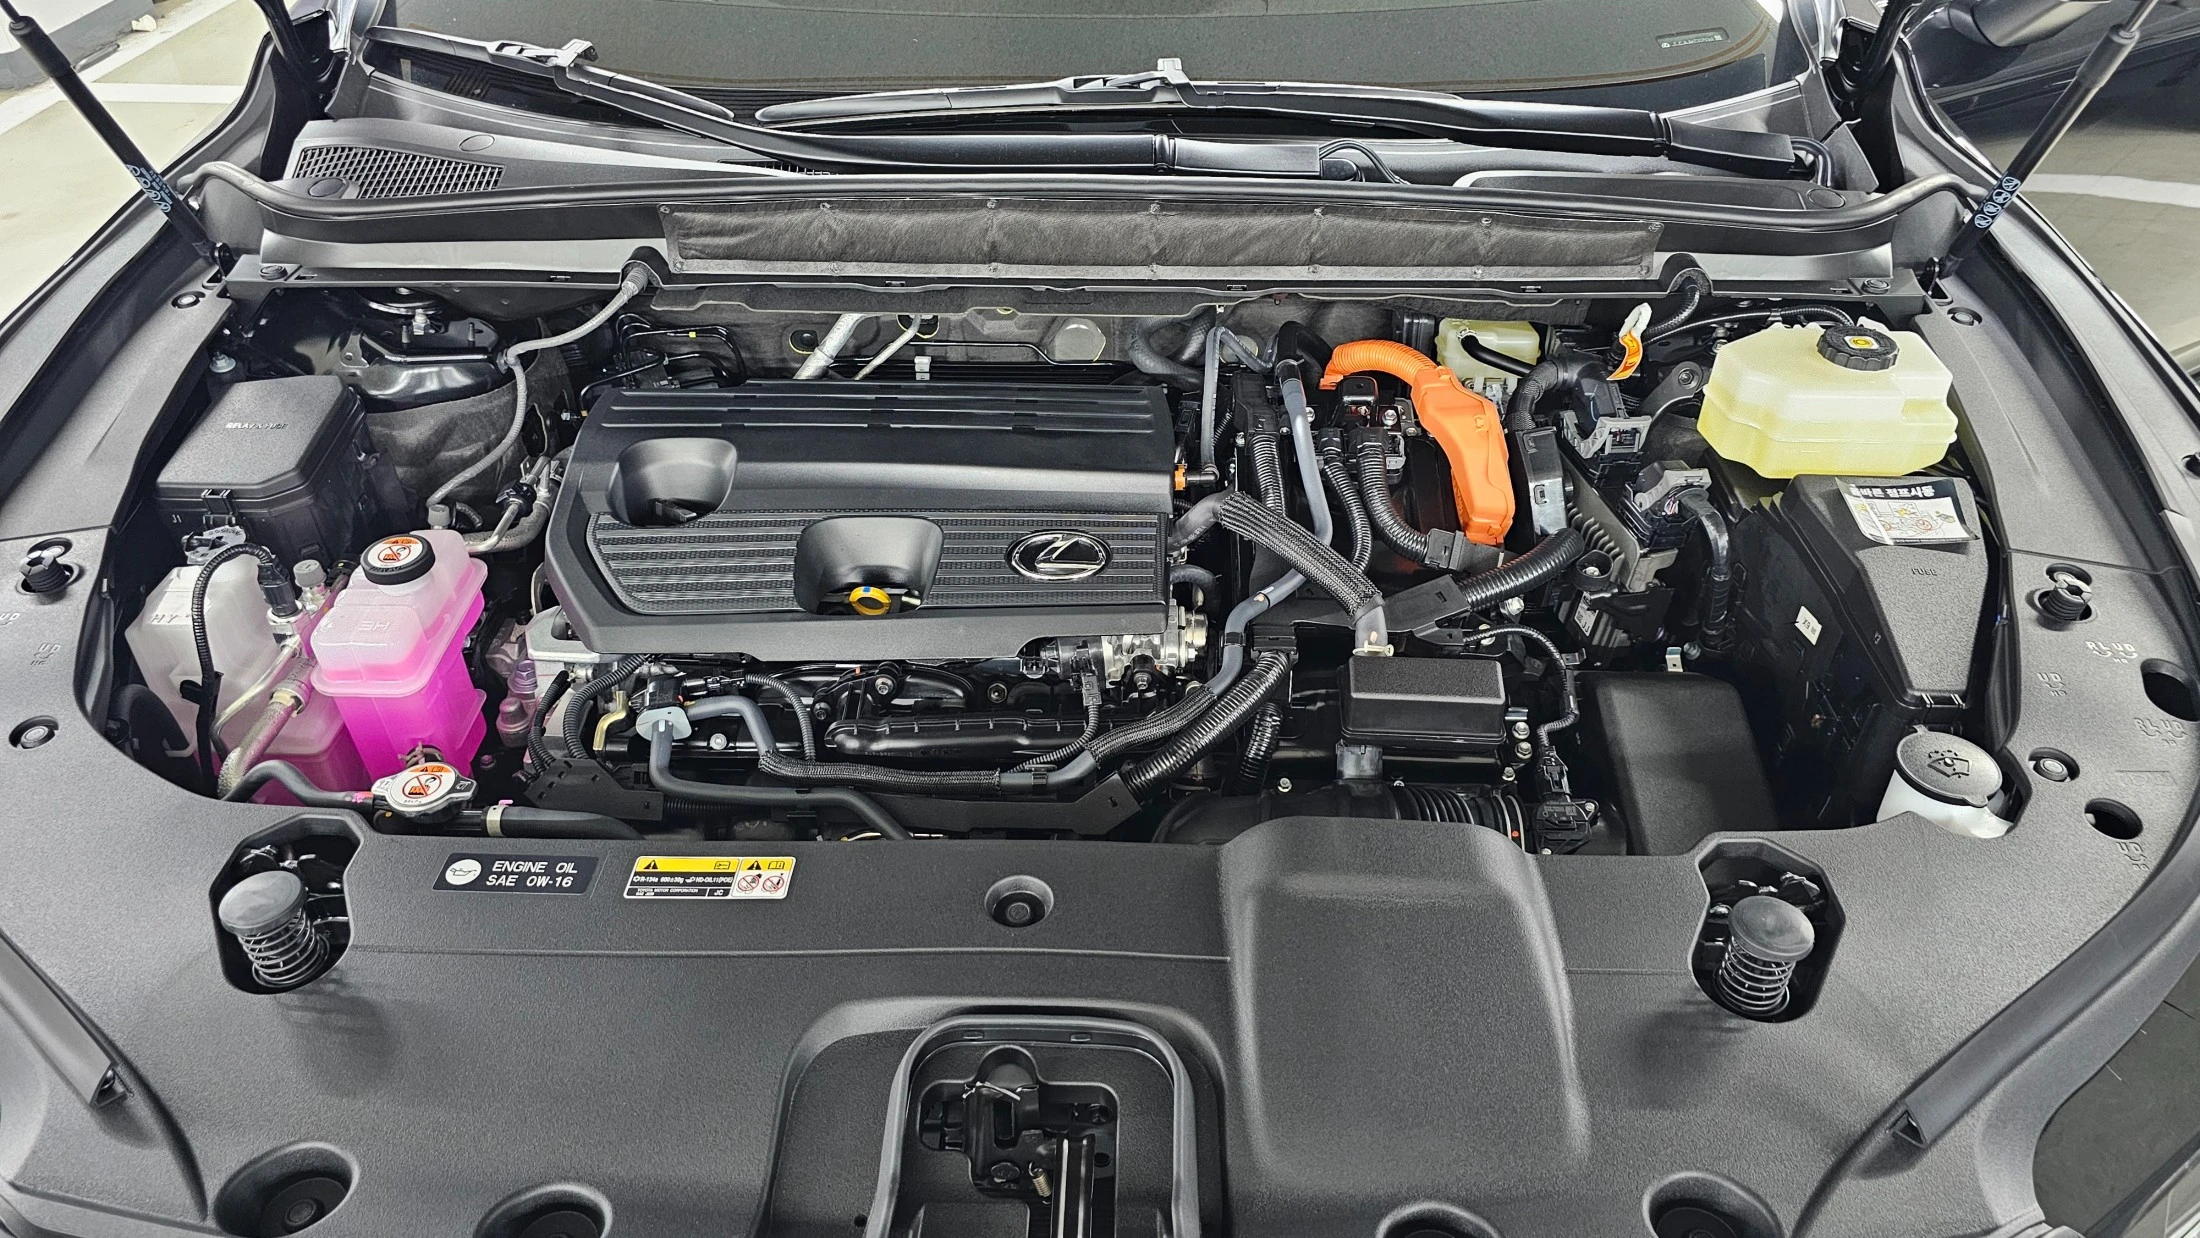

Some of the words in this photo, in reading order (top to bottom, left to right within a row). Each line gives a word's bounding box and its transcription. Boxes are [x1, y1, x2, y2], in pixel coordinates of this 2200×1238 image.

[1885, 485, 1935, 498] 점프시동
[492, 860, 548, 873] ENGINE
[555, 862, 578, 874] OIL
[486, 875, 519, 887] SAE
[526, 875, 573, 888] 0W-16
